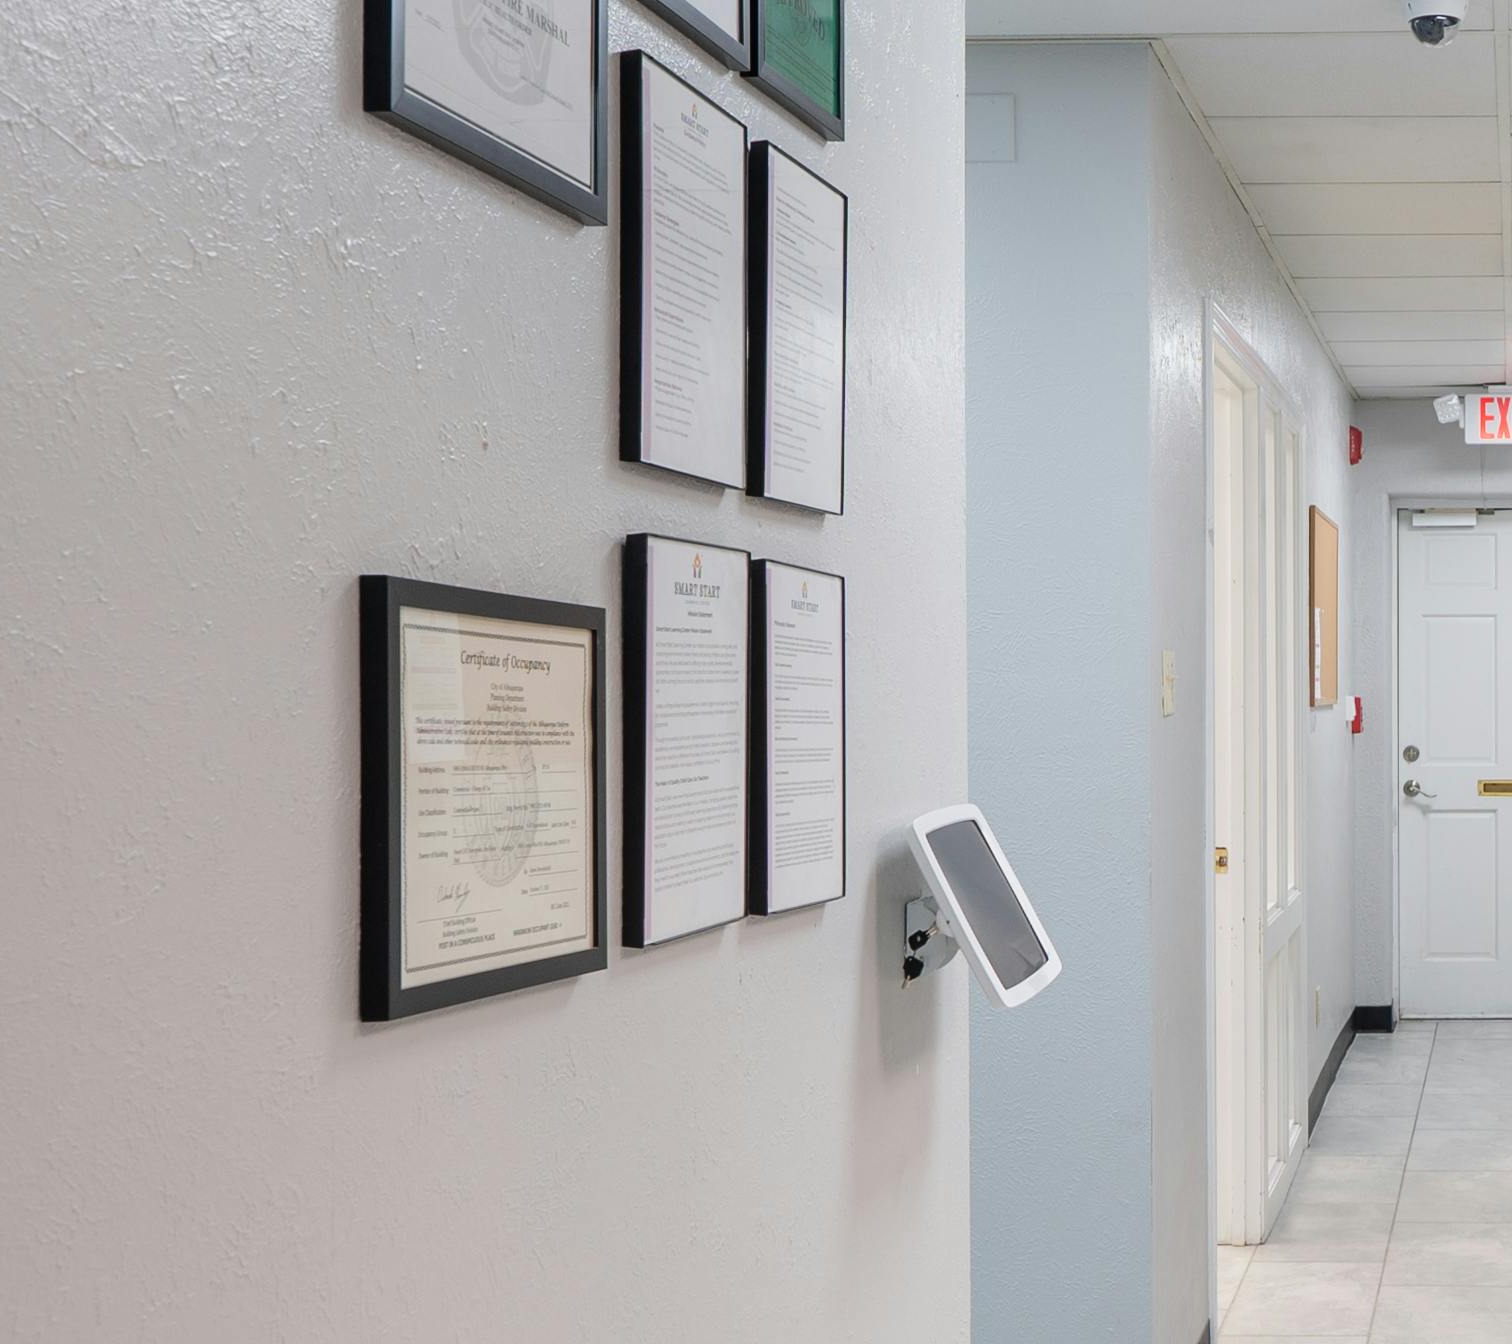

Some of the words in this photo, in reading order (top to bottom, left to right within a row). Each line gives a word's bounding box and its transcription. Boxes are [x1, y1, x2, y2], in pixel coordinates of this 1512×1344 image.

[526, 4, 570, 47] MARSHAL
[674, 582, 698, 596] SMART
[699, 584, 720, 599] START
[460, 649, 500, 671] Certificate
[502, 653, 511, 673] of
[511, 656, 551, 676] Occupancy
